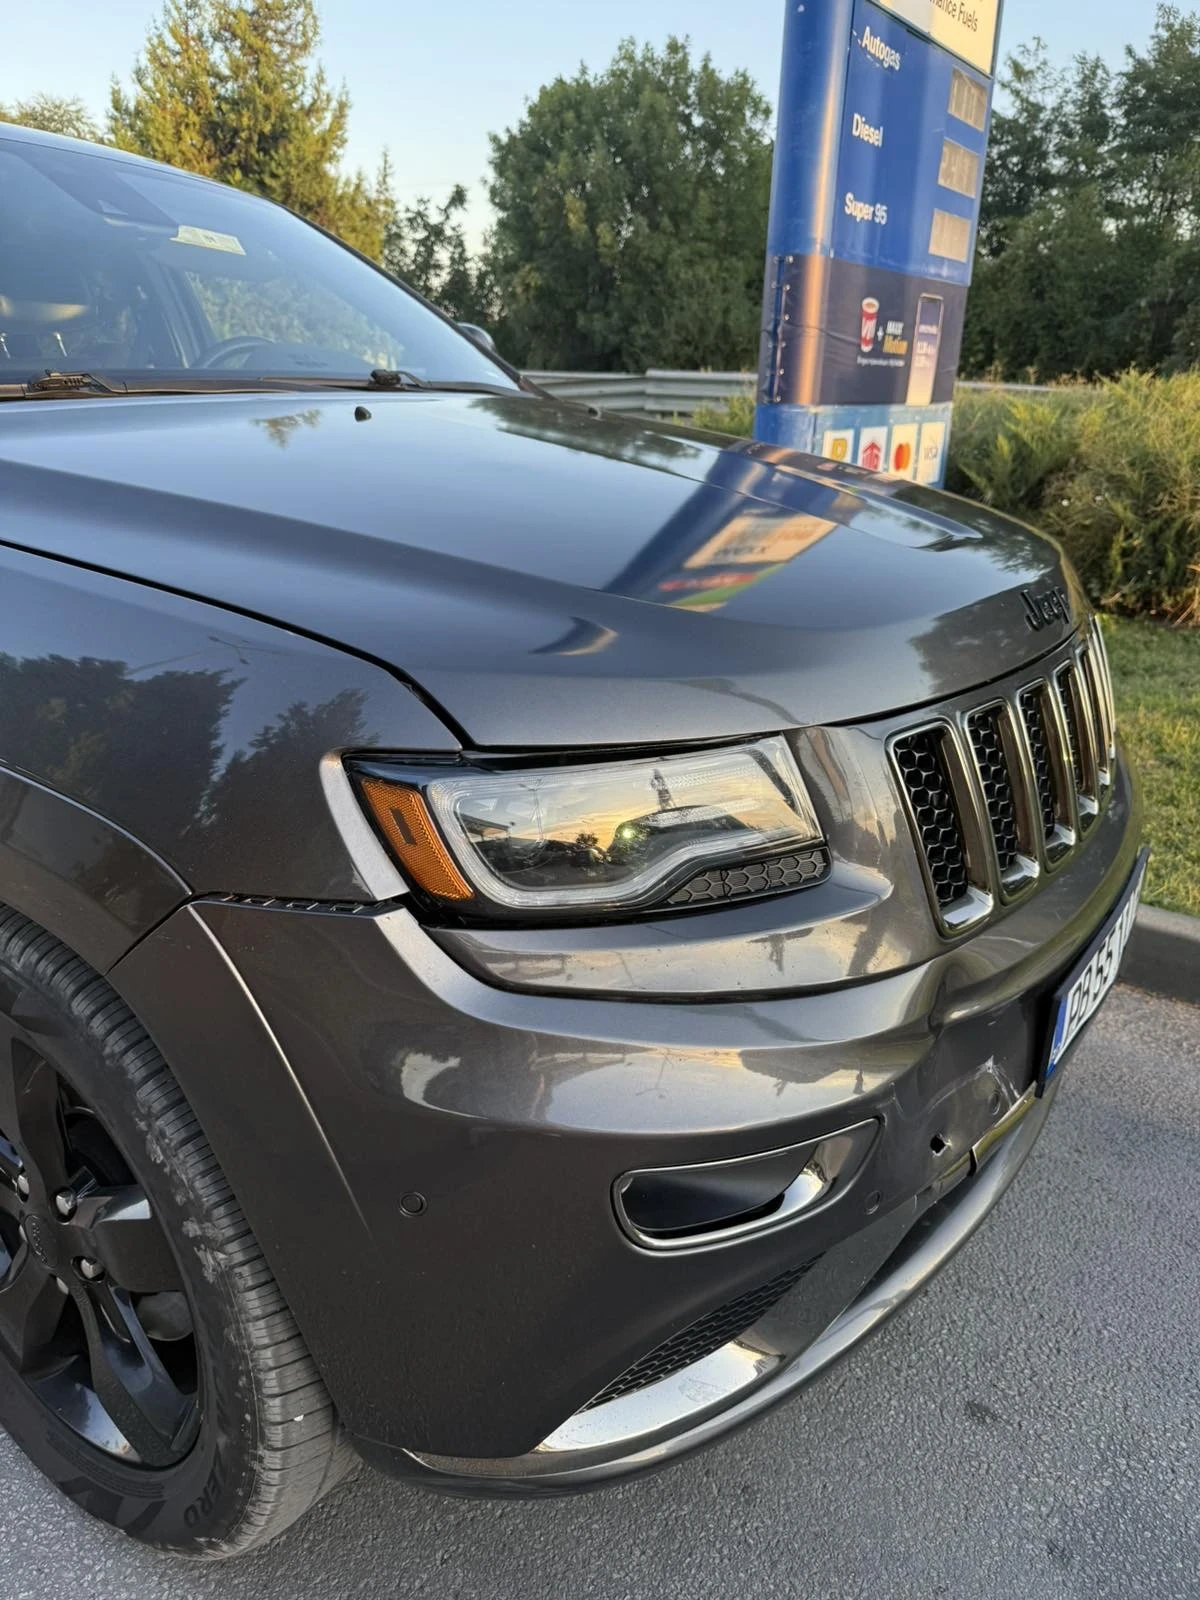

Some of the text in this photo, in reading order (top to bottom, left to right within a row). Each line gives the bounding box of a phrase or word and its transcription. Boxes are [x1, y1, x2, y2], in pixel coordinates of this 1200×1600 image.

[957, 2, 978, 32] Fuels
[861, 26, 901, 70] Autogas
[852, 113, 884, 147] Diesel
[844, 192, 888, 225] Super 95
